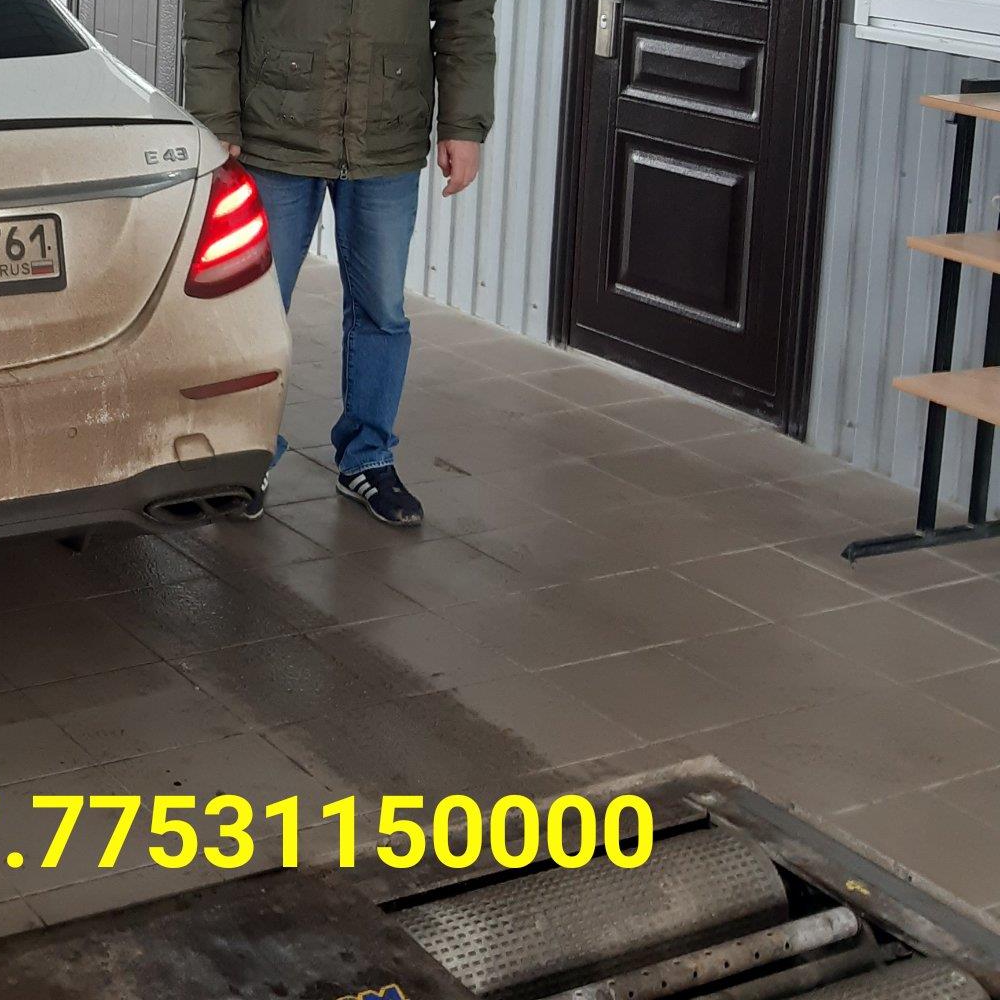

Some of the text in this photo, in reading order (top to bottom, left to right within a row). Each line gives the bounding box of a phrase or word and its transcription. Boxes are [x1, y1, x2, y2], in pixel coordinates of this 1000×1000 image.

[144, 147, 189, 165] E 43
[0, 262, 31, 278] RUS
